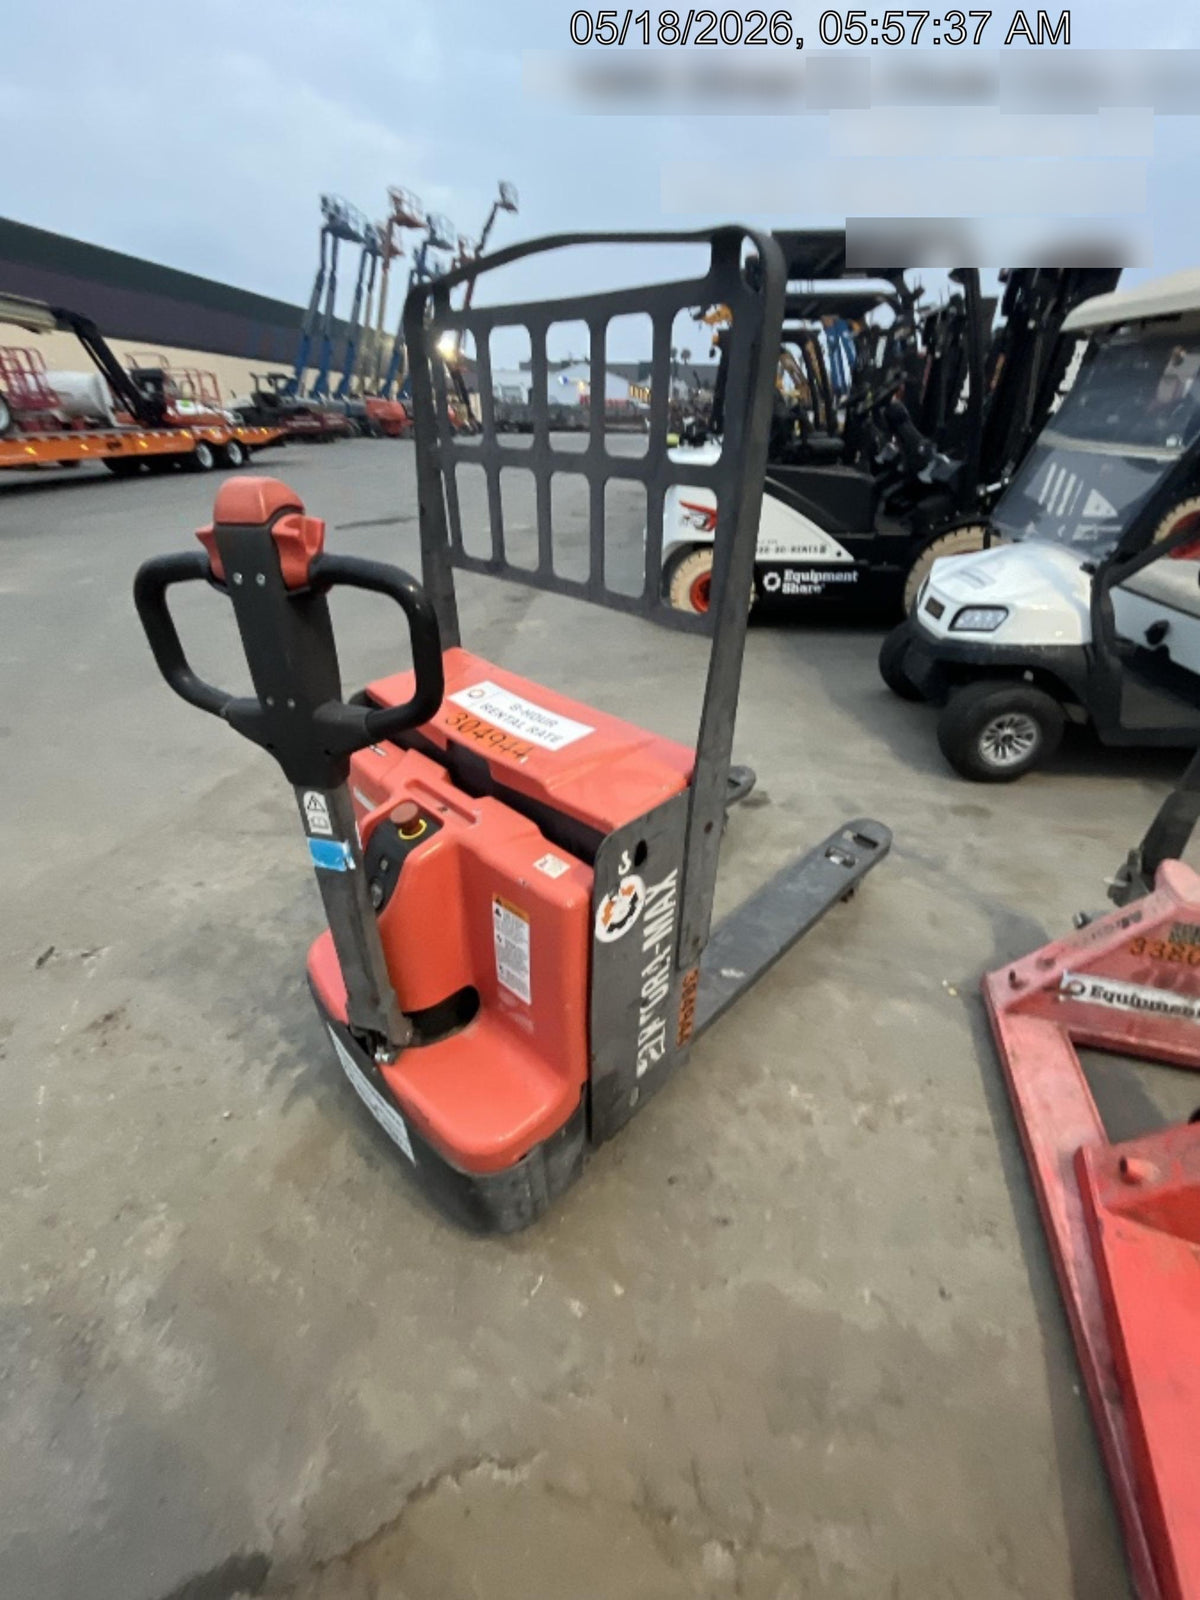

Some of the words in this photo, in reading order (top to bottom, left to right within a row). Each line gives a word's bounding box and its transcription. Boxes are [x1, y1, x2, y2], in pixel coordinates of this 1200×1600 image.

[784, 569, 858, 584] Equipment
[782, 581, 823, 594] Share
[480, 703, 525, 728] RENTAL
[526, 725, 563, 743] RATE
